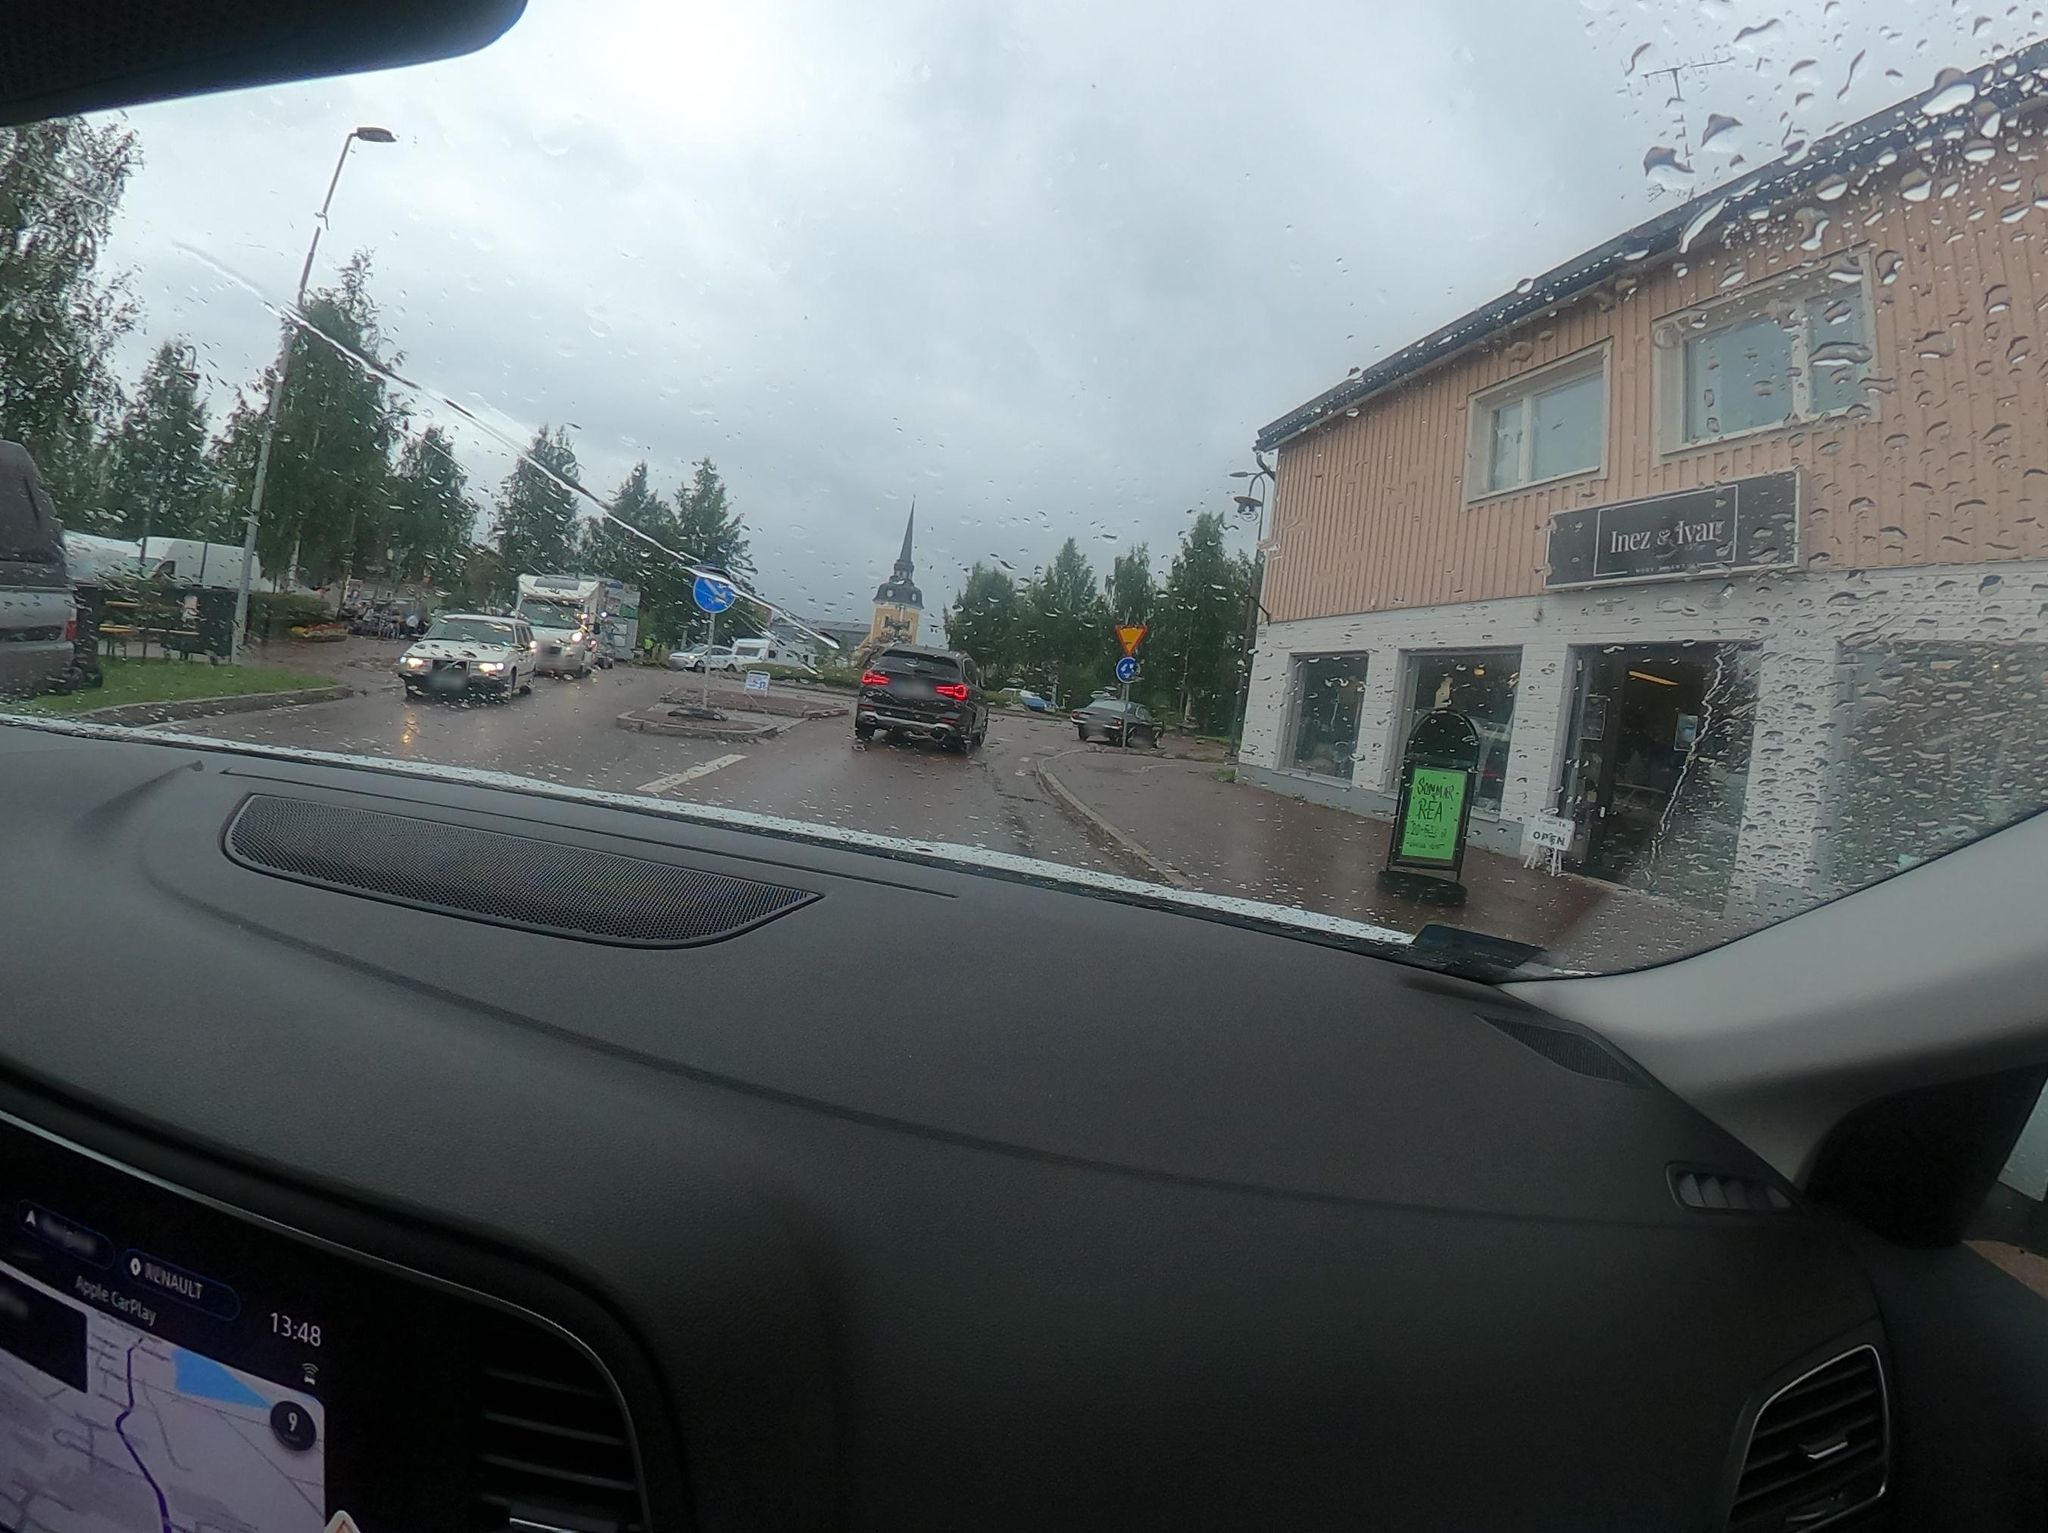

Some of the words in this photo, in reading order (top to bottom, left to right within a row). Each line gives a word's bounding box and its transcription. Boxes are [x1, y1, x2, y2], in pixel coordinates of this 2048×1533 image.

[1610, 529, 1651, 554] Inez
[1656, 529, 1672, 546] &
[1676, 519, 1726, 546] Ivar
[1417, 797, 1444, 823] REA
[1532, 831, 1566, 847] OPEN
[143, 1261, 204, 1300] RENAULT
[73, 1274, 109, 1302] Apple
[110, 1290, 157, 1327] CarPlay
[269, 1311, 322, 1347] 13:48
[288, 1412, 298, 1432] 9
